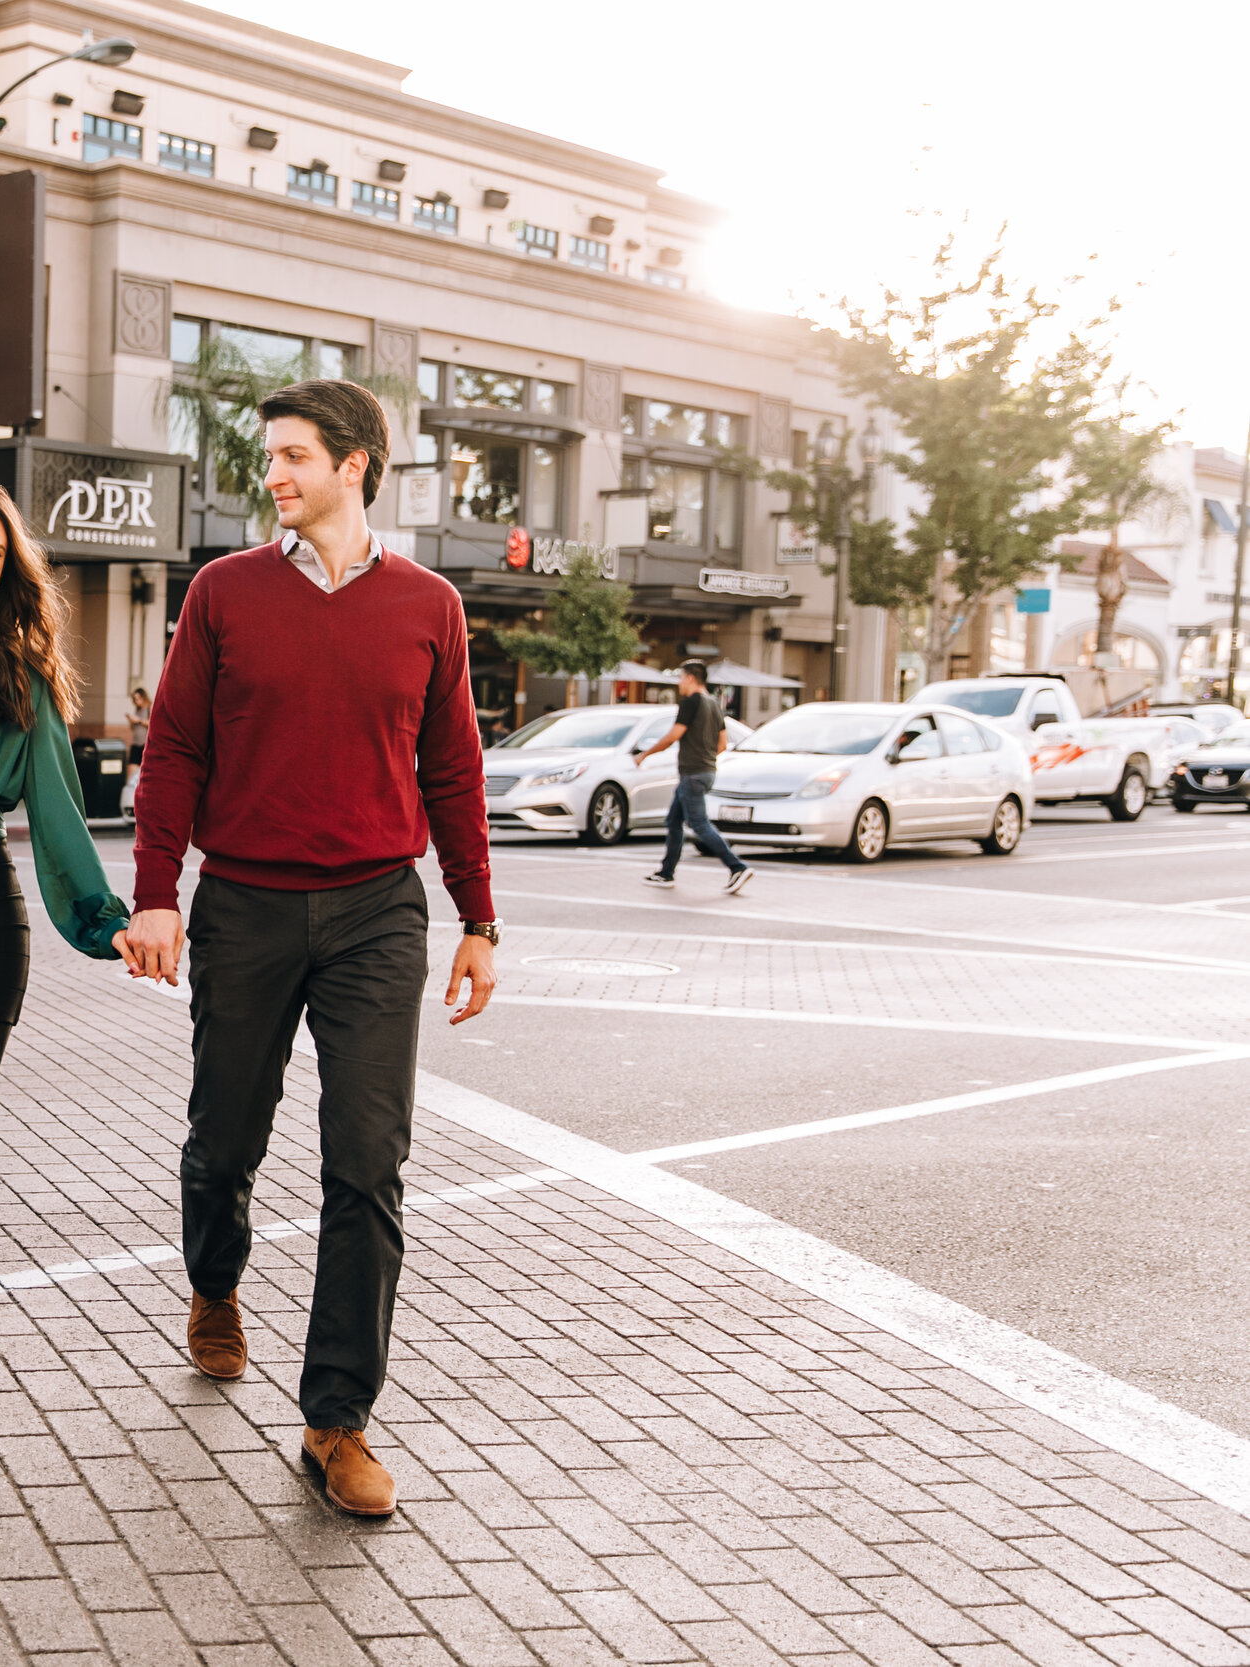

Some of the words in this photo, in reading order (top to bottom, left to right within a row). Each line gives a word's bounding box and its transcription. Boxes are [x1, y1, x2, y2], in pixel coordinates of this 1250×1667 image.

[66, 479, 157, 528] DPR
[66, 528, 157, 548] CONSTRUCTION
[533, 536, 620, 580] KABKI
